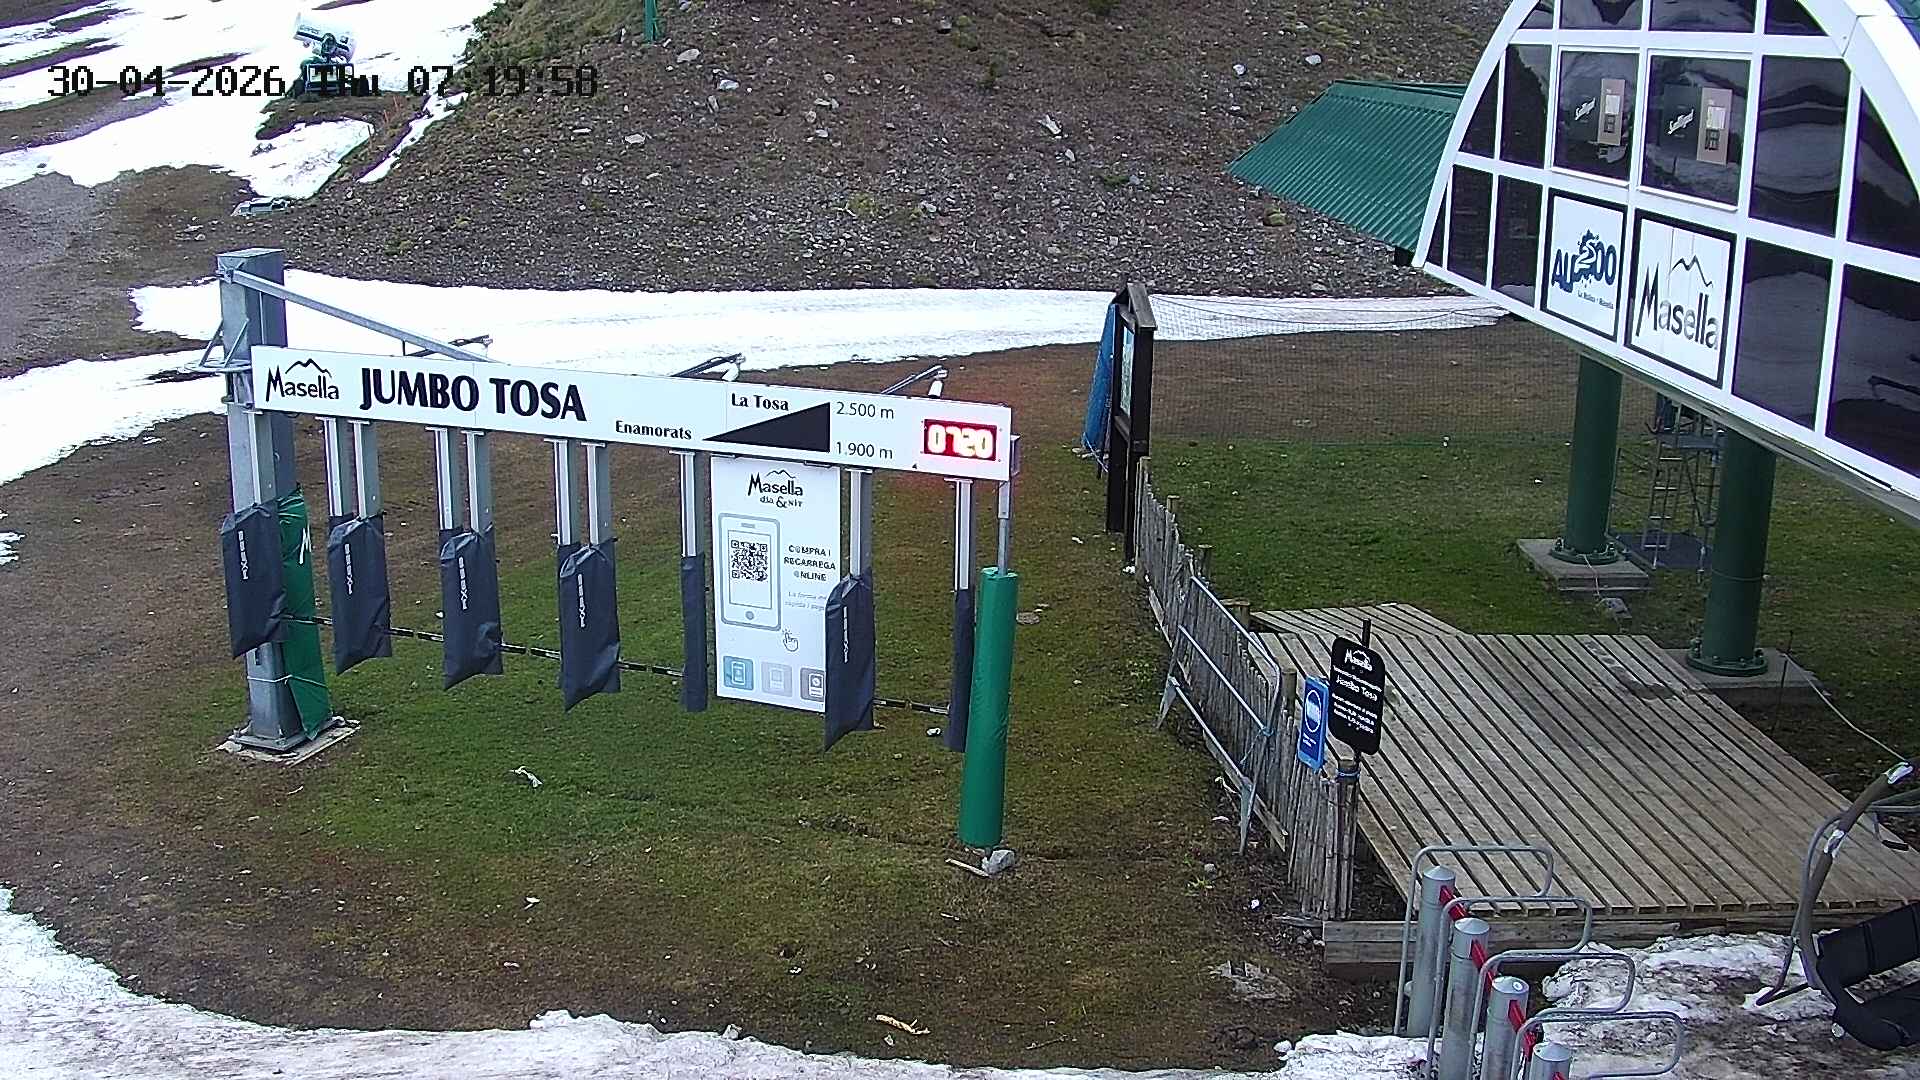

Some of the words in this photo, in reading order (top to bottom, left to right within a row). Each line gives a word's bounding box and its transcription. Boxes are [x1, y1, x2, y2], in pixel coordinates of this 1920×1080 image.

[1635, 262, 1719, 350] Masella
[266, 364, 340, 402] Masella
[360, 367, 479, 411] JUMBO
[489, 377, 587, 421] TOSA
[731, 393, 748, 407] La
[753, 394, 789, 411] Tosa
[836, 401, 876, 417] 2.500
[881, 406, 894, 419] m
[615, 420, 692, 440] Enamorats
[836, 441, 875, 457] 1.900
[879, 446, 893, 459] m
[748, 472, 803, 496] Masella
[788, 544, 827, 556] COMPRA
[783, 556, 836, 570] RECARREGA
